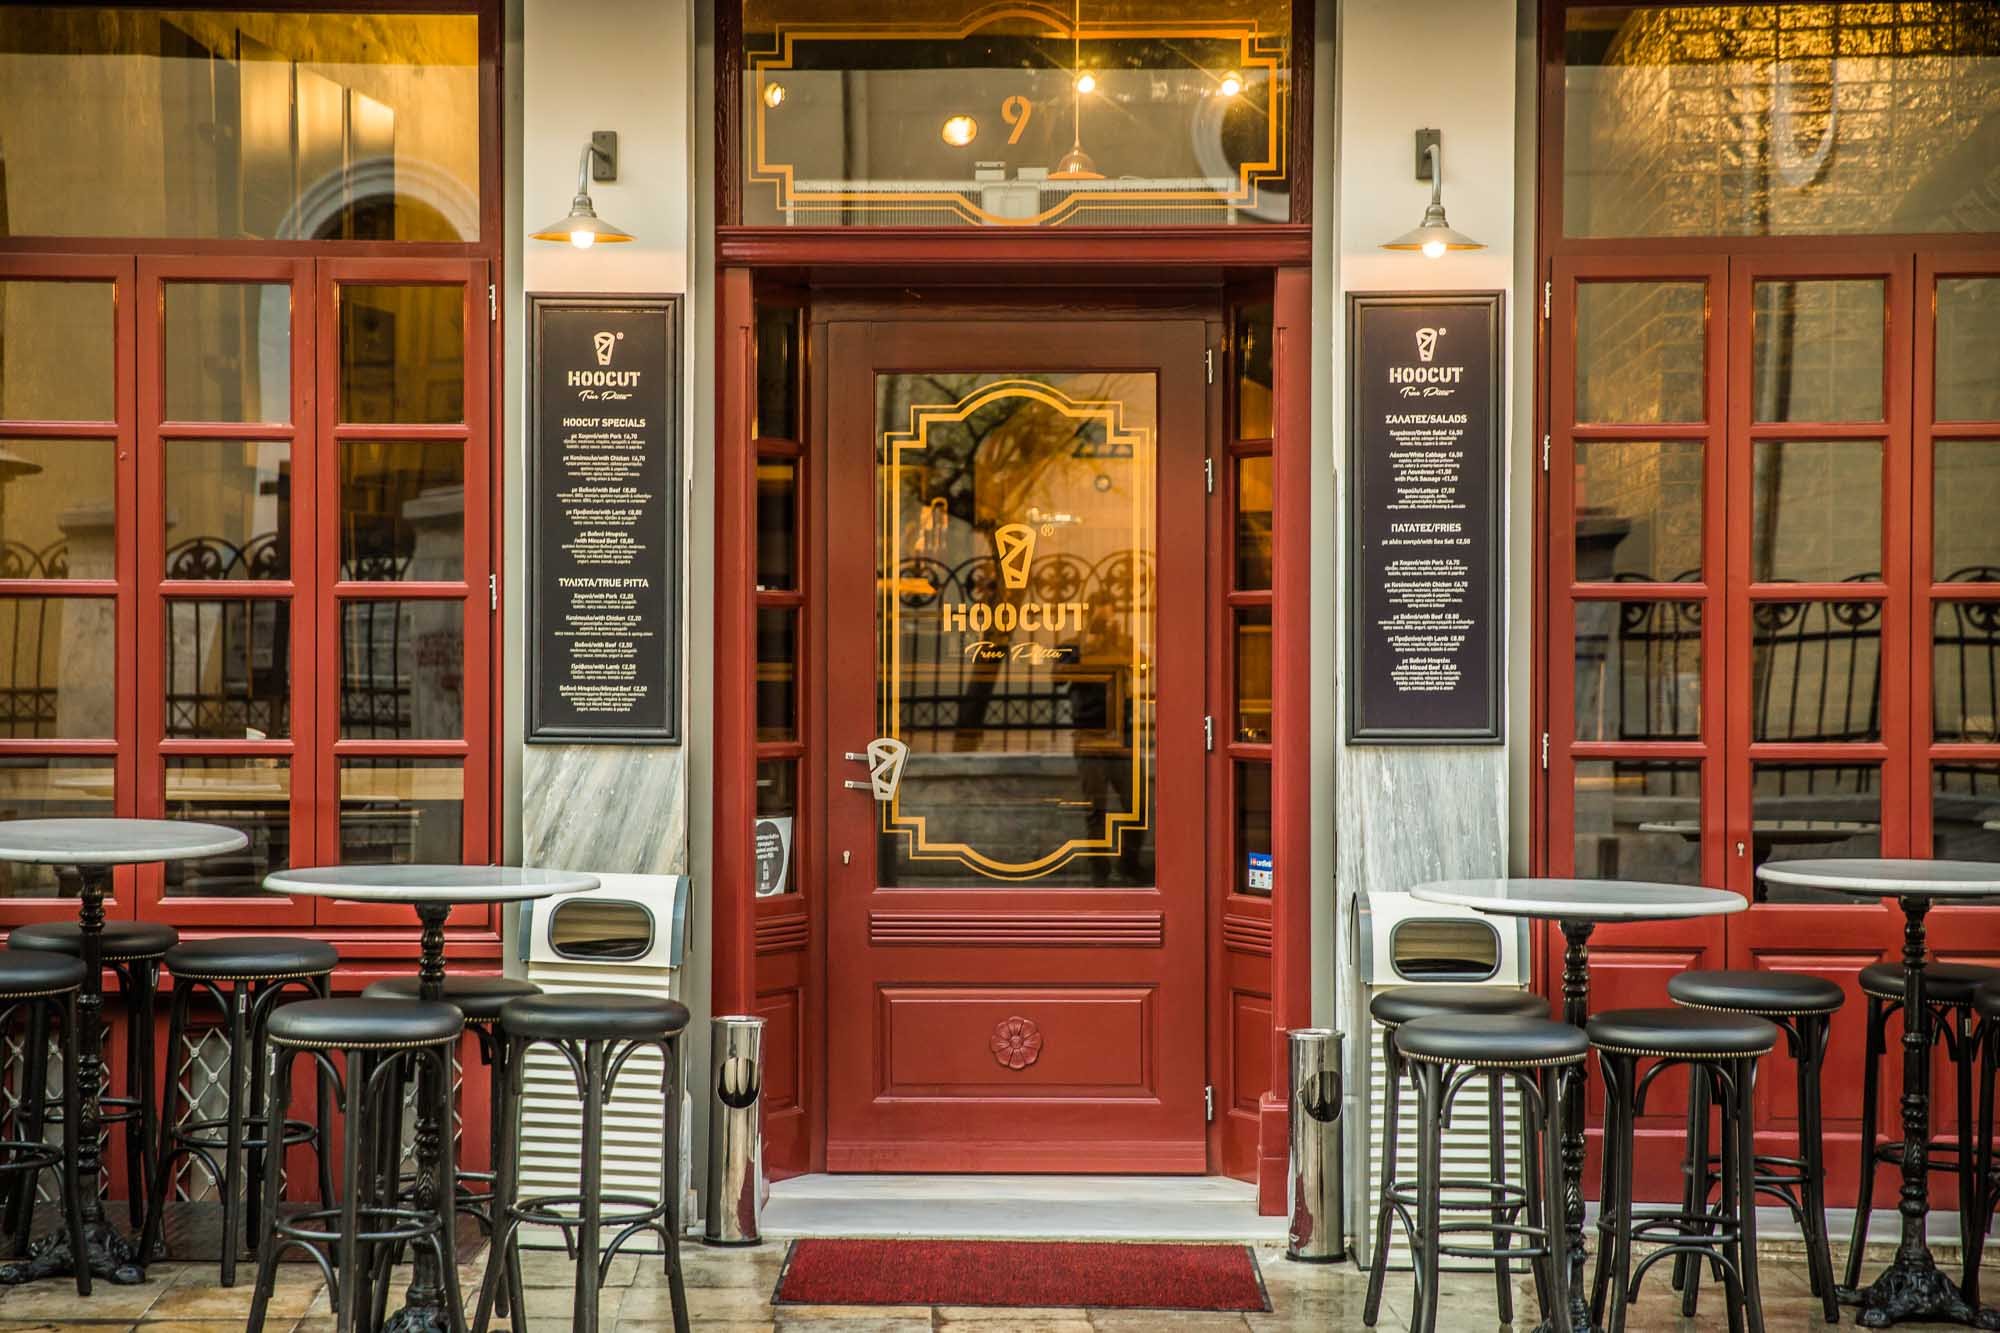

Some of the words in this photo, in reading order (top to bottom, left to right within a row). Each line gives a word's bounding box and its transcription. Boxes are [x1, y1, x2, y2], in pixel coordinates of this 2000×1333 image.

[1001, 96, 1032, 145] 9
[567, 370, 641, 387] HOOCUT
[1389, 367, 1464, 384] HOOCUT
[563, 417, 600, 428] HOOCUT
[601, 417, 647, 428] SPECIALS
[1385, 414, 1468, 424] ΣΑΛΑΤΕΣ/SALADS
[1391, 523, 1462, 533] ΠΑΤΑΤΕΣ/FRIES
[558, 578, 622, 588] ΤΥΛΙΧΤΑ/TRUE
[624, 578, 649, 588] PITTA
[943, 602, 1090, 632] HOOCUT
[964, 641, 1005, 664] True
